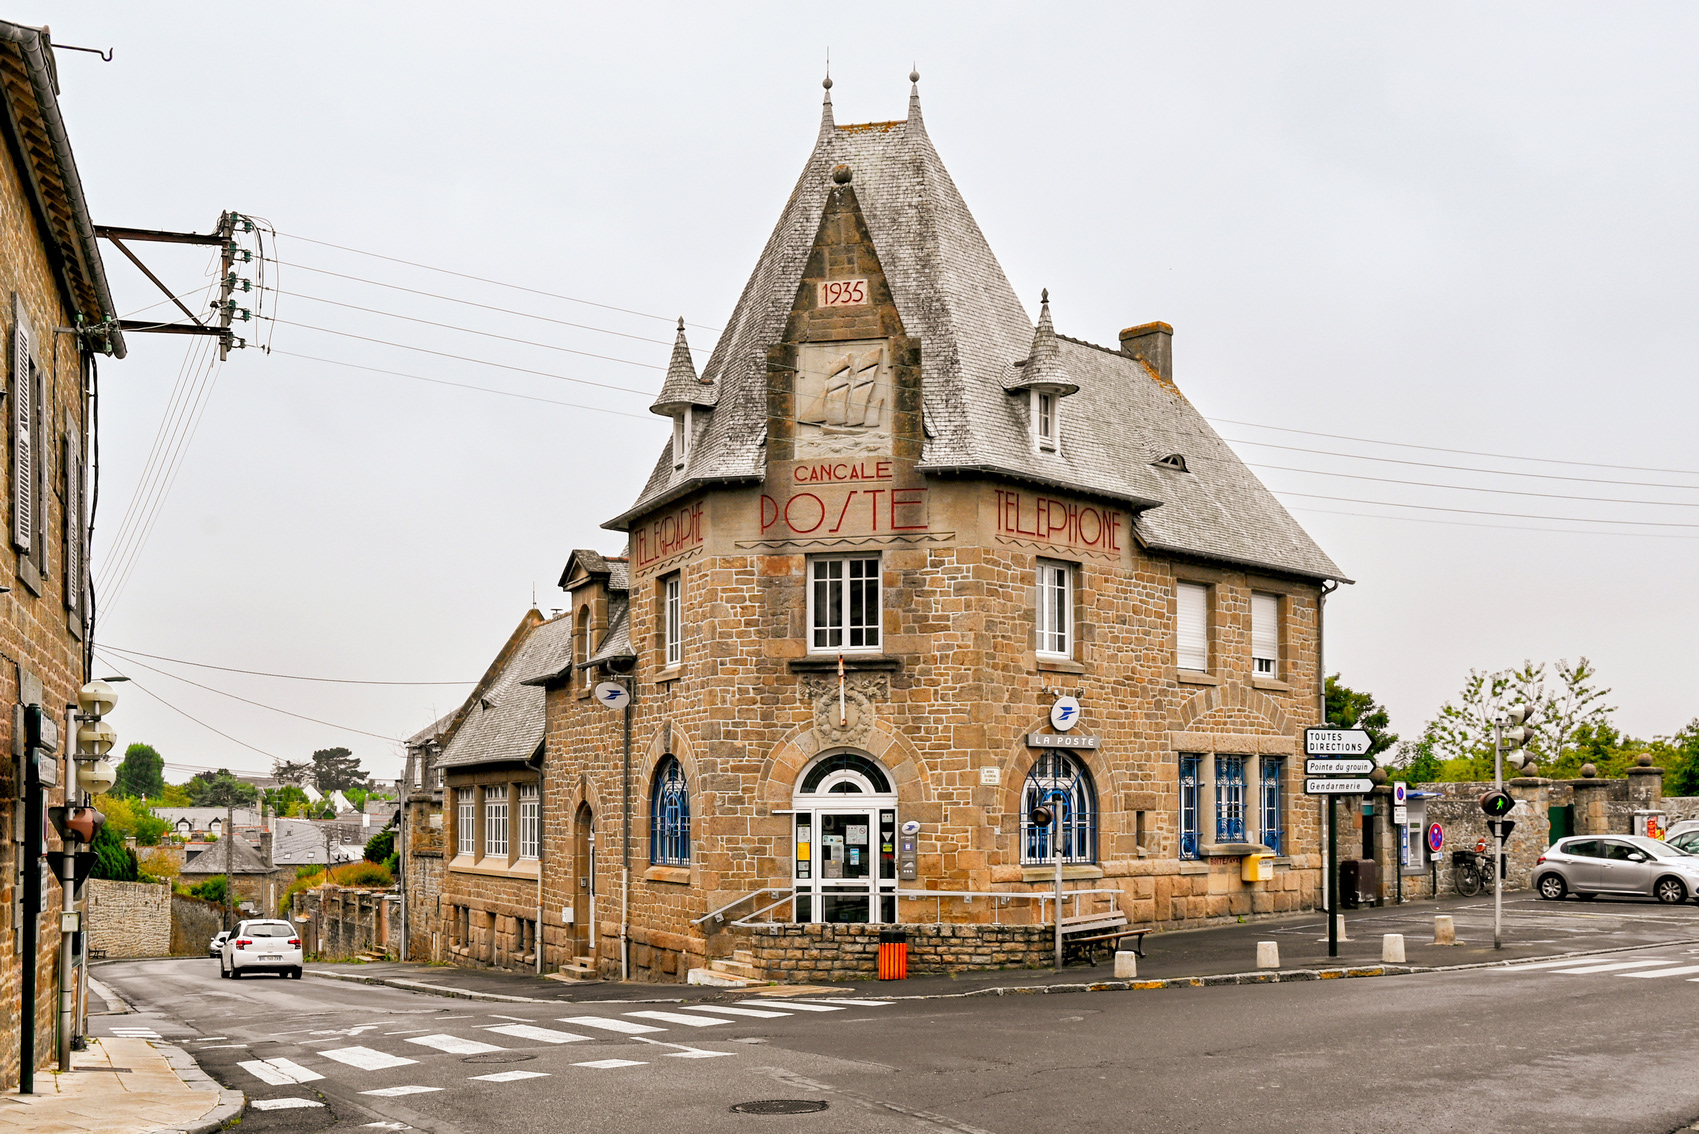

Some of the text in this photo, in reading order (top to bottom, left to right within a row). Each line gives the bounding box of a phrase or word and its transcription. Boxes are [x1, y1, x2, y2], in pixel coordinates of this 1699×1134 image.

[821, 280, 865, 305] 1935
[793, 461, 893, 482] CANCALE
[760, 487, 928, 535] POSTE
[994, 489, 1121, 551] TELEPHONE
[634, 500, 704, 568] TELEGRAPHE
[1057, 737, 1094, 745] POSTE
[1310, 732, 1343, 741] TOUTES
[1310, 743, 1362, 751] DIRECTIONS
[1310, 762, 1369, 772] Pointe du grouin
[1310, 782, 1361, 790] Gendarmerie
